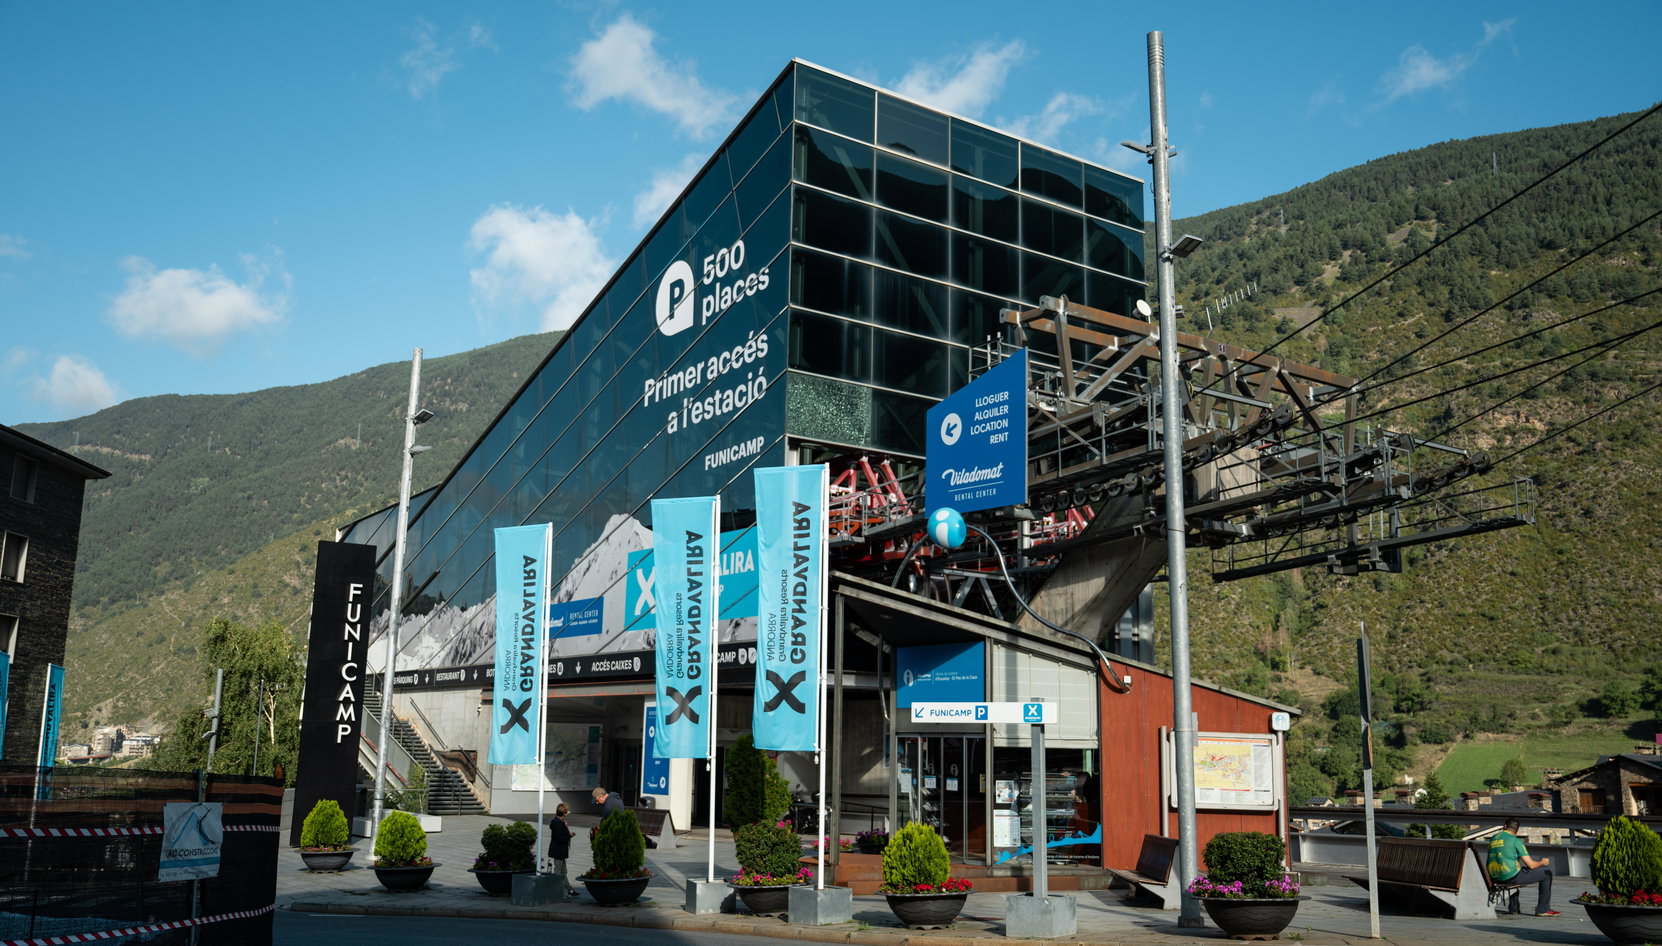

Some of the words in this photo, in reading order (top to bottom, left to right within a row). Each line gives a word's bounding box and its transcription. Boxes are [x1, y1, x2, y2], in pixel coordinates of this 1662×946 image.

[703, 240, 745, 285] 500
[702, 267, 770, 325] places
[643, 361, 704, 407] Primer
[707, 331, 768, 380] accés
[667, 410, 678, 434] a
[683, 367, 767, 428] l'estació
[976, 391, 1009, 408] LLOGUER
[974, 405, 1009, 422] ALQUILER
[970, 418, 1009, 435] LOCATION
[990, 432, 1009, 445] RENT
[705, 435, 765, 471] FUNICAMP
[942, 462, 1004, 486] Viladomat
[954, 491, 974, 501] RENTAL
[976, 488, 996, 499] CENTER
[335, 583, 364, 744] FUNICAMP
[591, 659, 611, 672] ACCÉS
[611, 660, 632, 671] CAIXES
[436, 672, 460, 681] RESTAURANT
[930, 709, 972, 717] FUNICAMP
